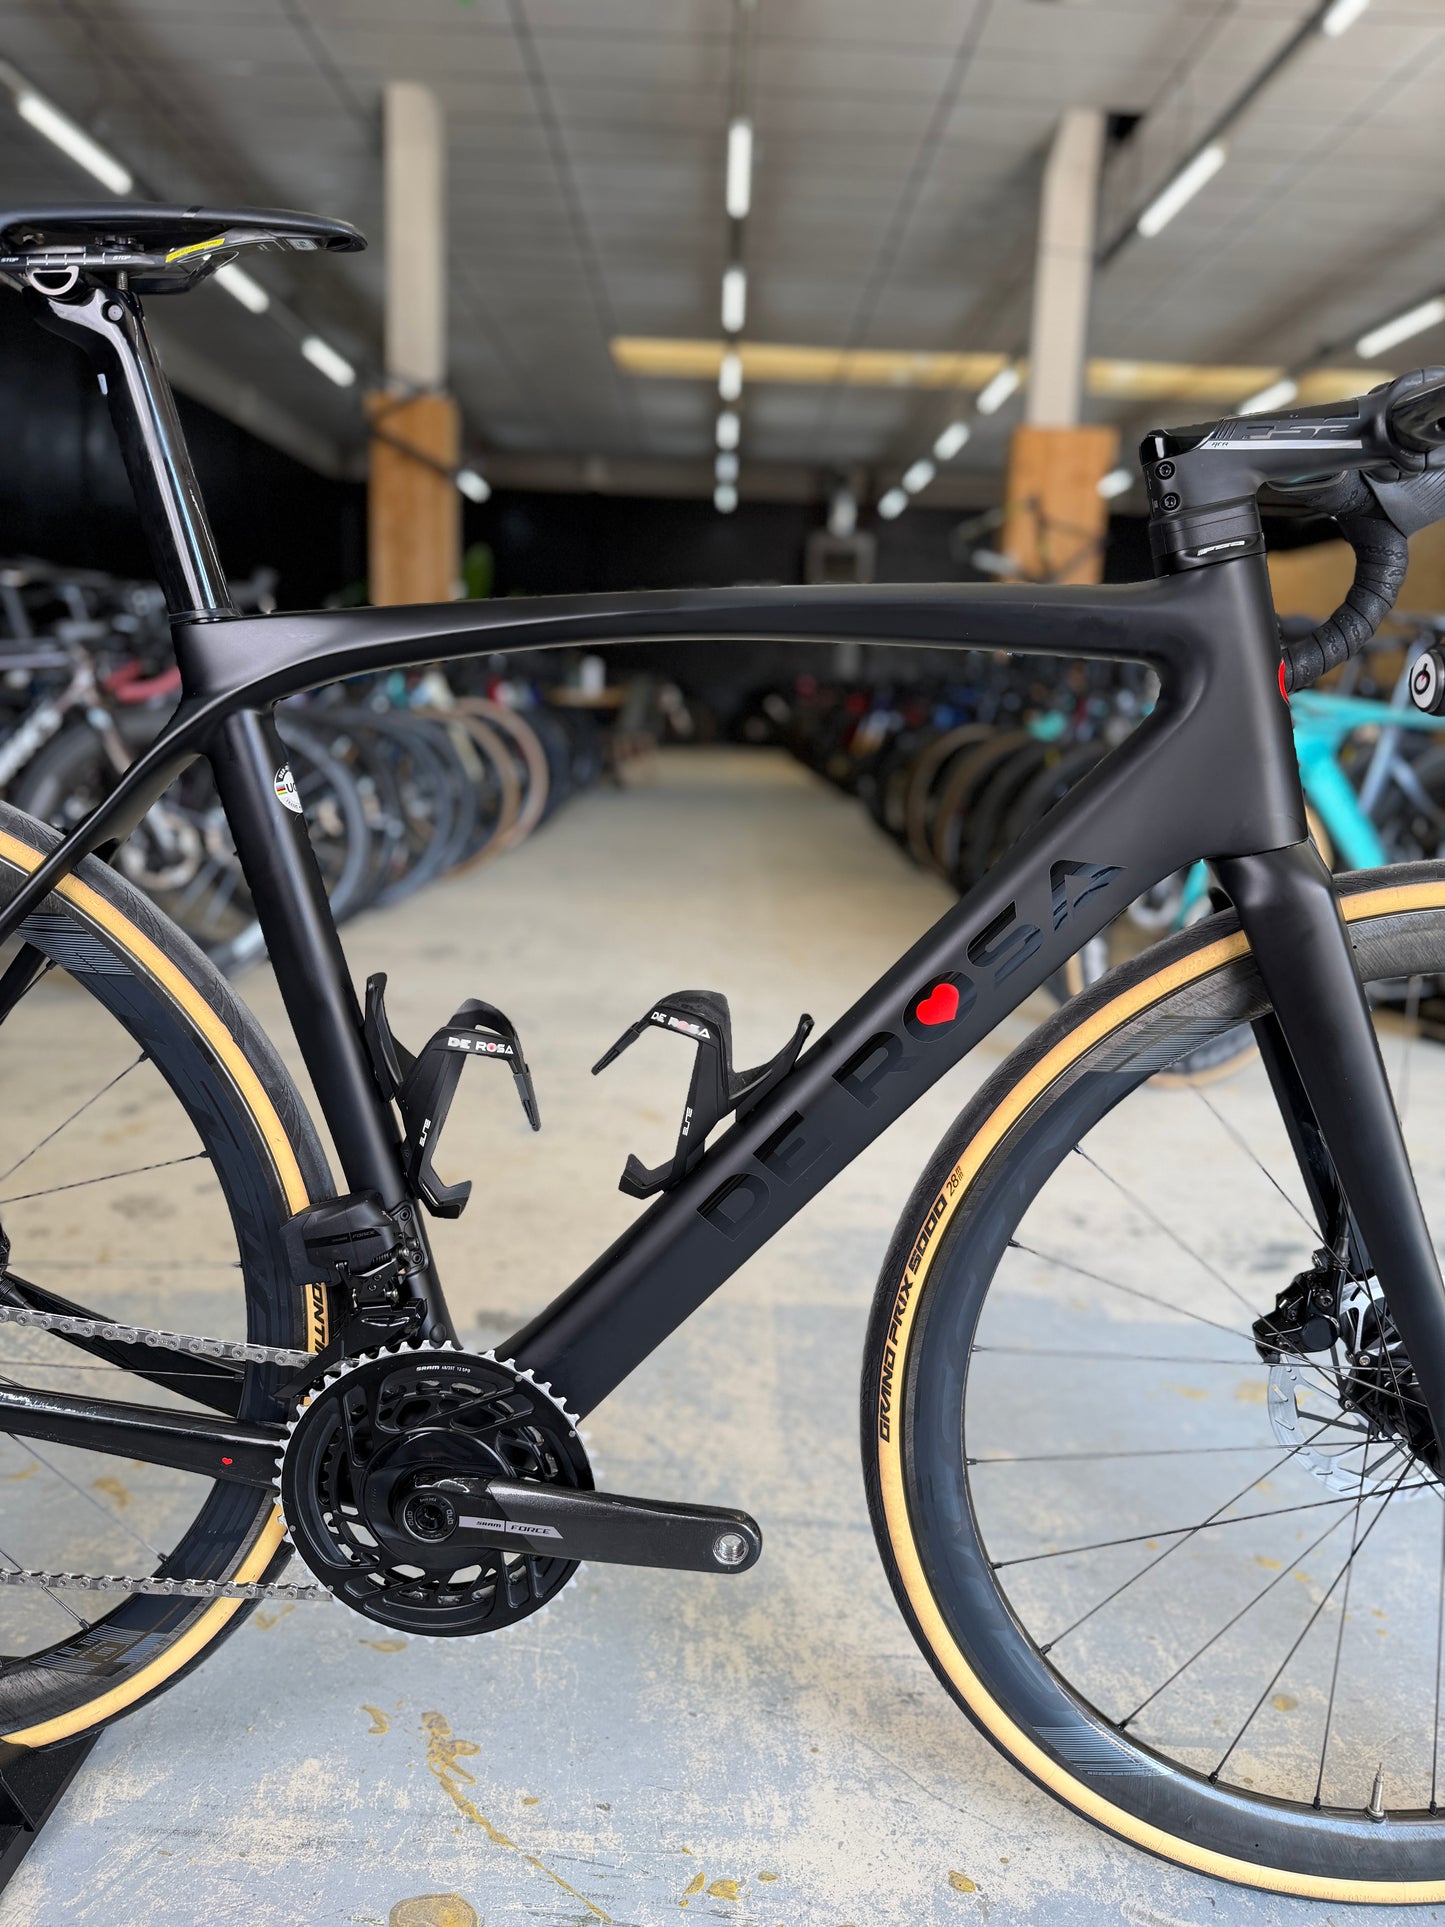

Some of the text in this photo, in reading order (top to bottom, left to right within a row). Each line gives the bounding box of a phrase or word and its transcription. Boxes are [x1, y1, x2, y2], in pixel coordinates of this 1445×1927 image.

[650, 1011, 711, 1039] DE ROSA
[447, 1036, 513, 1055] DE ROSA
[696, 859, 1128, 1242] DE ROSA
[880, 1351, 896, 1443] GRAND
[889, 1273, 914, 1344] PRIX
[908, 1193, 948, 1275] 5000
[476, 1520, 552, 1535] SRAM FORCE
